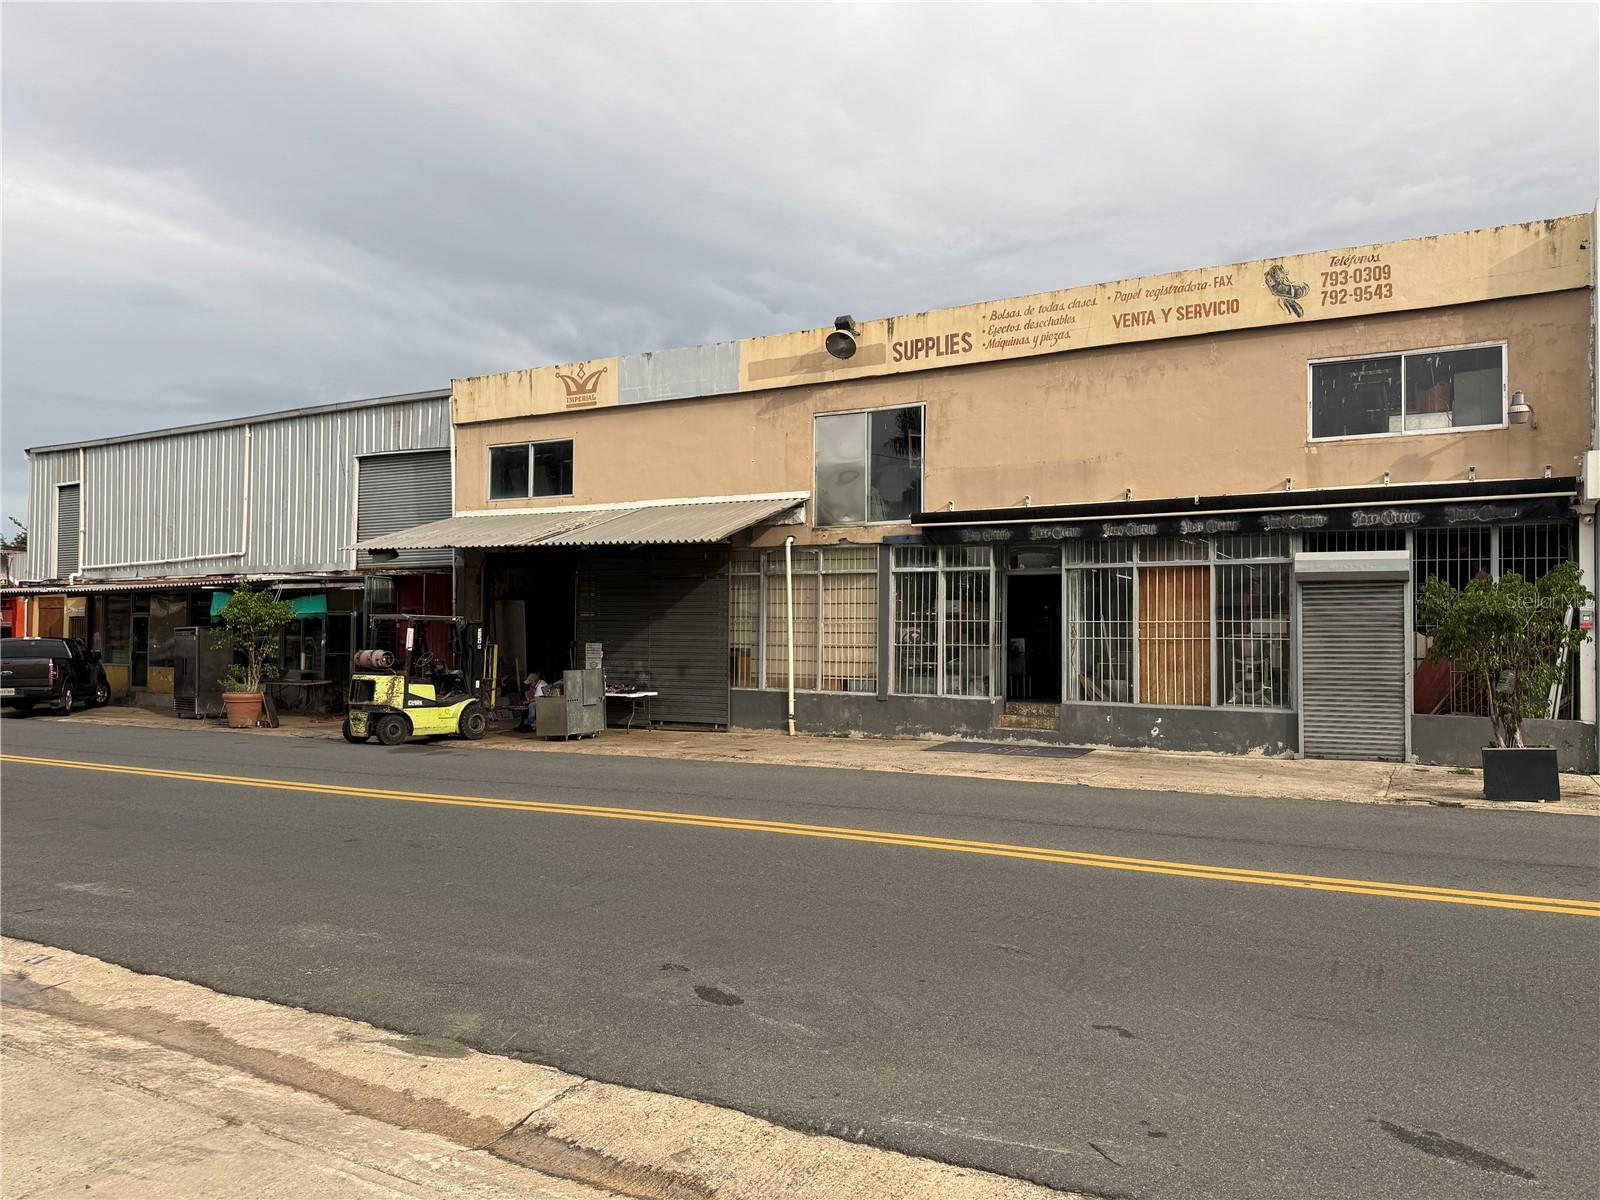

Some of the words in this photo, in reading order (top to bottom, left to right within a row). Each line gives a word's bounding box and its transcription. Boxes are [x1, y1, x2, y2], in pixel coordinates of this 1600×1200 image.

[1329, 253, 1381, 268] Teléfonos
[1320, 264, 1392, 288] 793-0309
[1113, 288, 1142, 303] Papel
[1213, 274, 1233, 288] FAX
[1320, 283, 1393, 306] 792-9543
[989, 309, 1022, 321] Bolsas
[1024, 304, 1035, 317] de
[1038, 301, 1065, 314] todas
[1067, 298, 1098, 310] clases
[1112, 309, 1156, 329] VENTA
[1160, 307, 1173, 323] Y
[1176, 298, 1240, 321] SERVICIO
[1023, 314, 1076, 330] desechables
[892, 332, 973, 362] SUPPLIES
[1031, 335, 1039, 350] y
[1039, 330, 1072, 347] piezas
[566, 394, 597, 404] IMPERIAL
